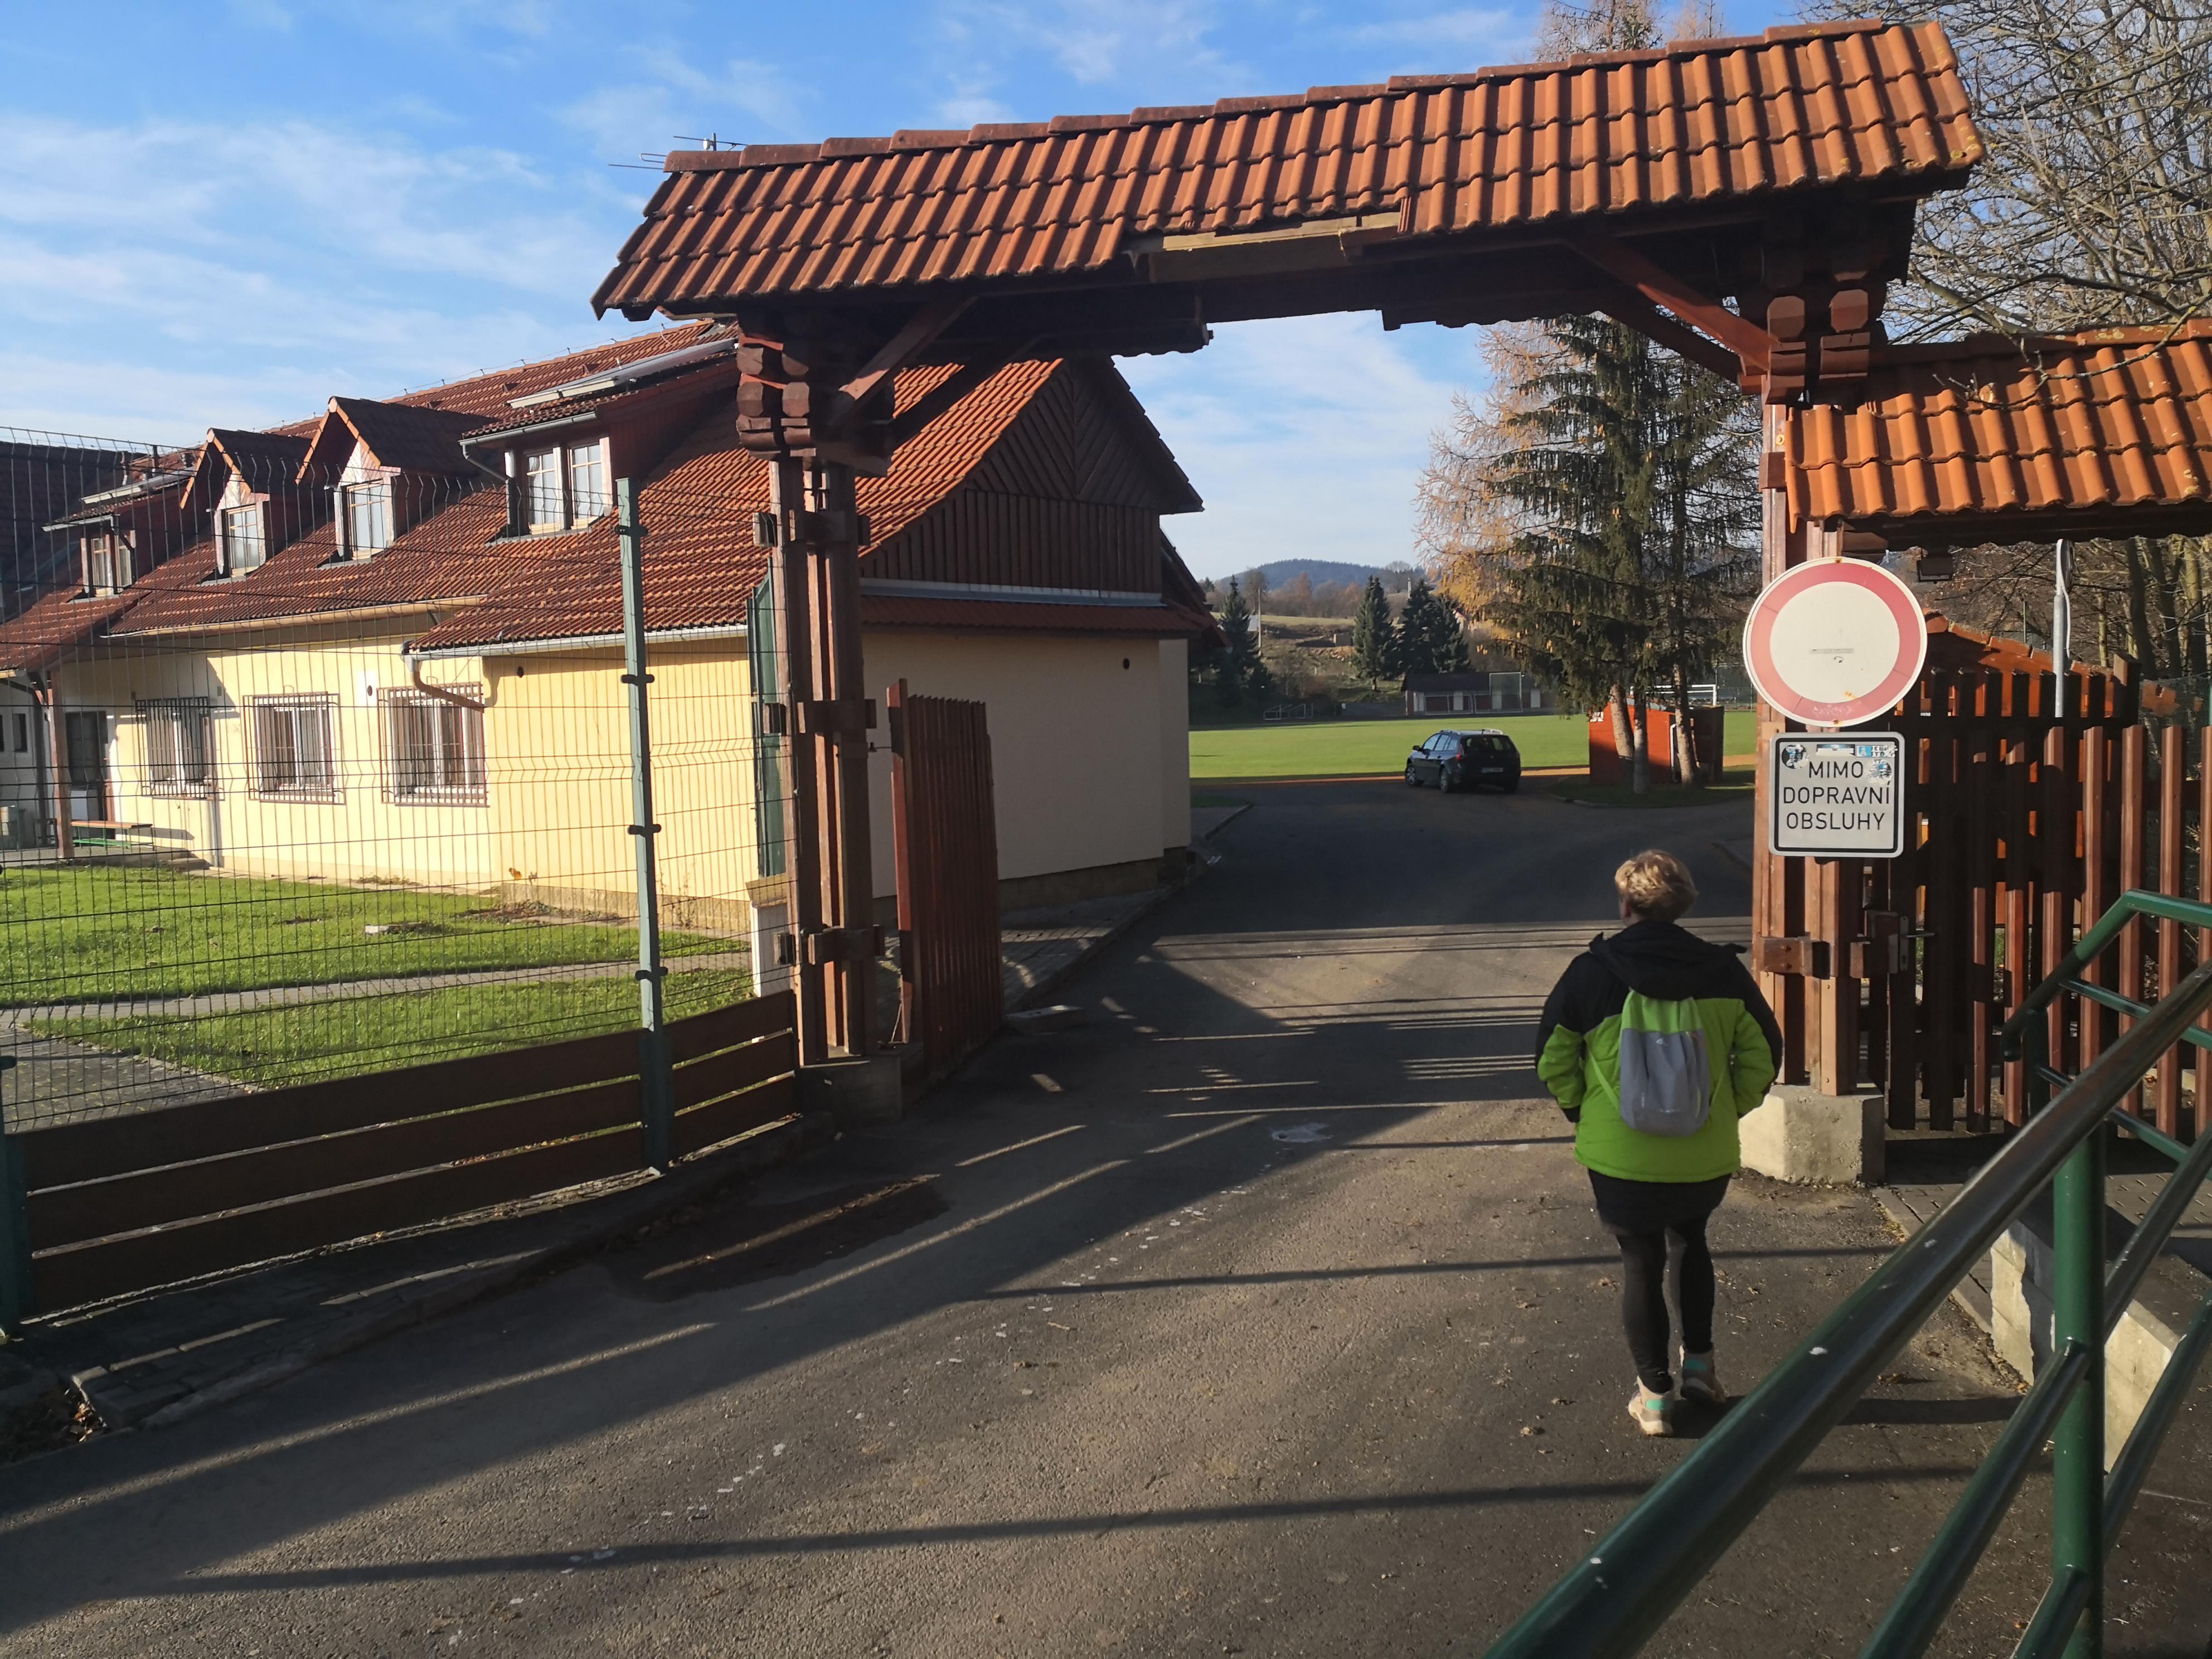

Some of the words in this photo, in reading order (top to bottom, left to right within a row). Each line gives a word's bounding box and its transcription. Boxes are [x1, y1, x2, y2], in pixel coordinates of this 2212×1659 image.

[1808, 761, 1864, 778] MIMO
[1783, 780, 1890, 804] DOPRAVNÍ
[1786, 812, 1885, 830] OBSLUHY
